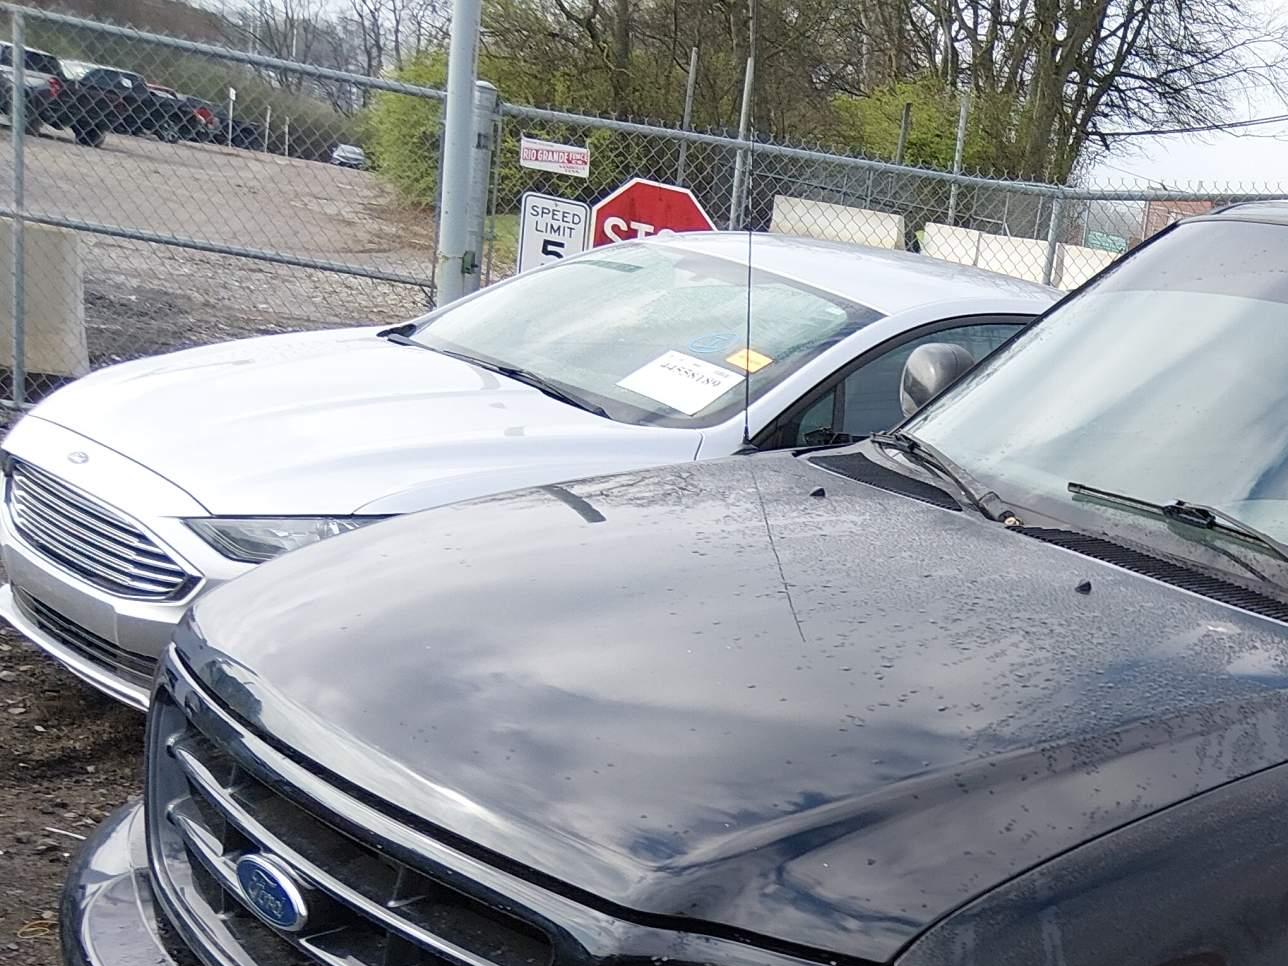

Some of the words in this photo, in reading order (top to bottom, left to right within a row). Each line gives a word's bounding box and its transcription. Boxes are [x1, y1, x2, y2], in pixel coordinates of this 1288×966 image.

[523, 148, 537, 161] RIO
[537, 150, 569, 163] GRANDE
[530, 205, 581, 225] SPEED
[535, 220, 575, 239] LIMIT
[541, 238, 565, 266] 5
